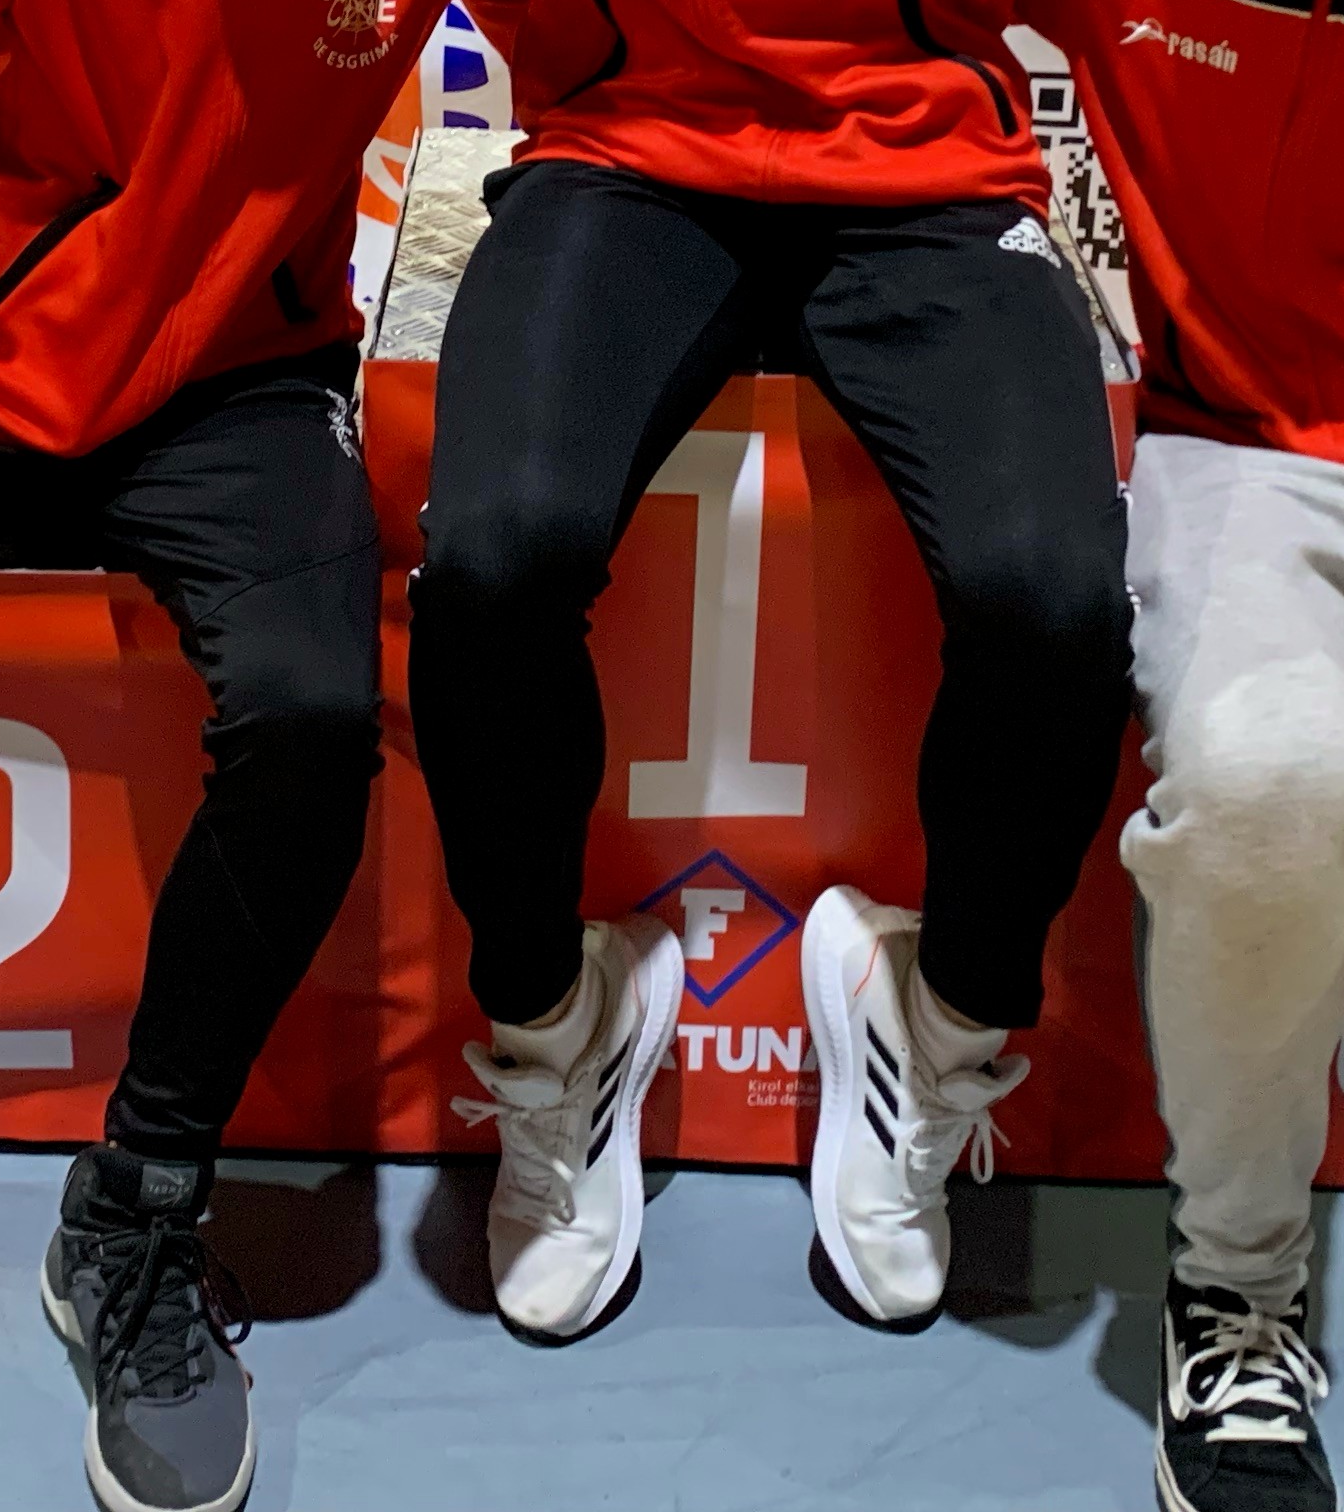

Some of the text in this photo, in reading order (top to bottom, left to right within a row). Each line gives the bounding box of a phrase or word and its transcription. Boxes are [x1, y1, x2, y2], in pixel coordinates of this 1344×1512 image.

[313, 33, 398, 69] DE ESGRIMA
[628, 430, 808, 819] 1
[680, 888, 746, 961] F
[660, 1024, 819, 1073] TUN
